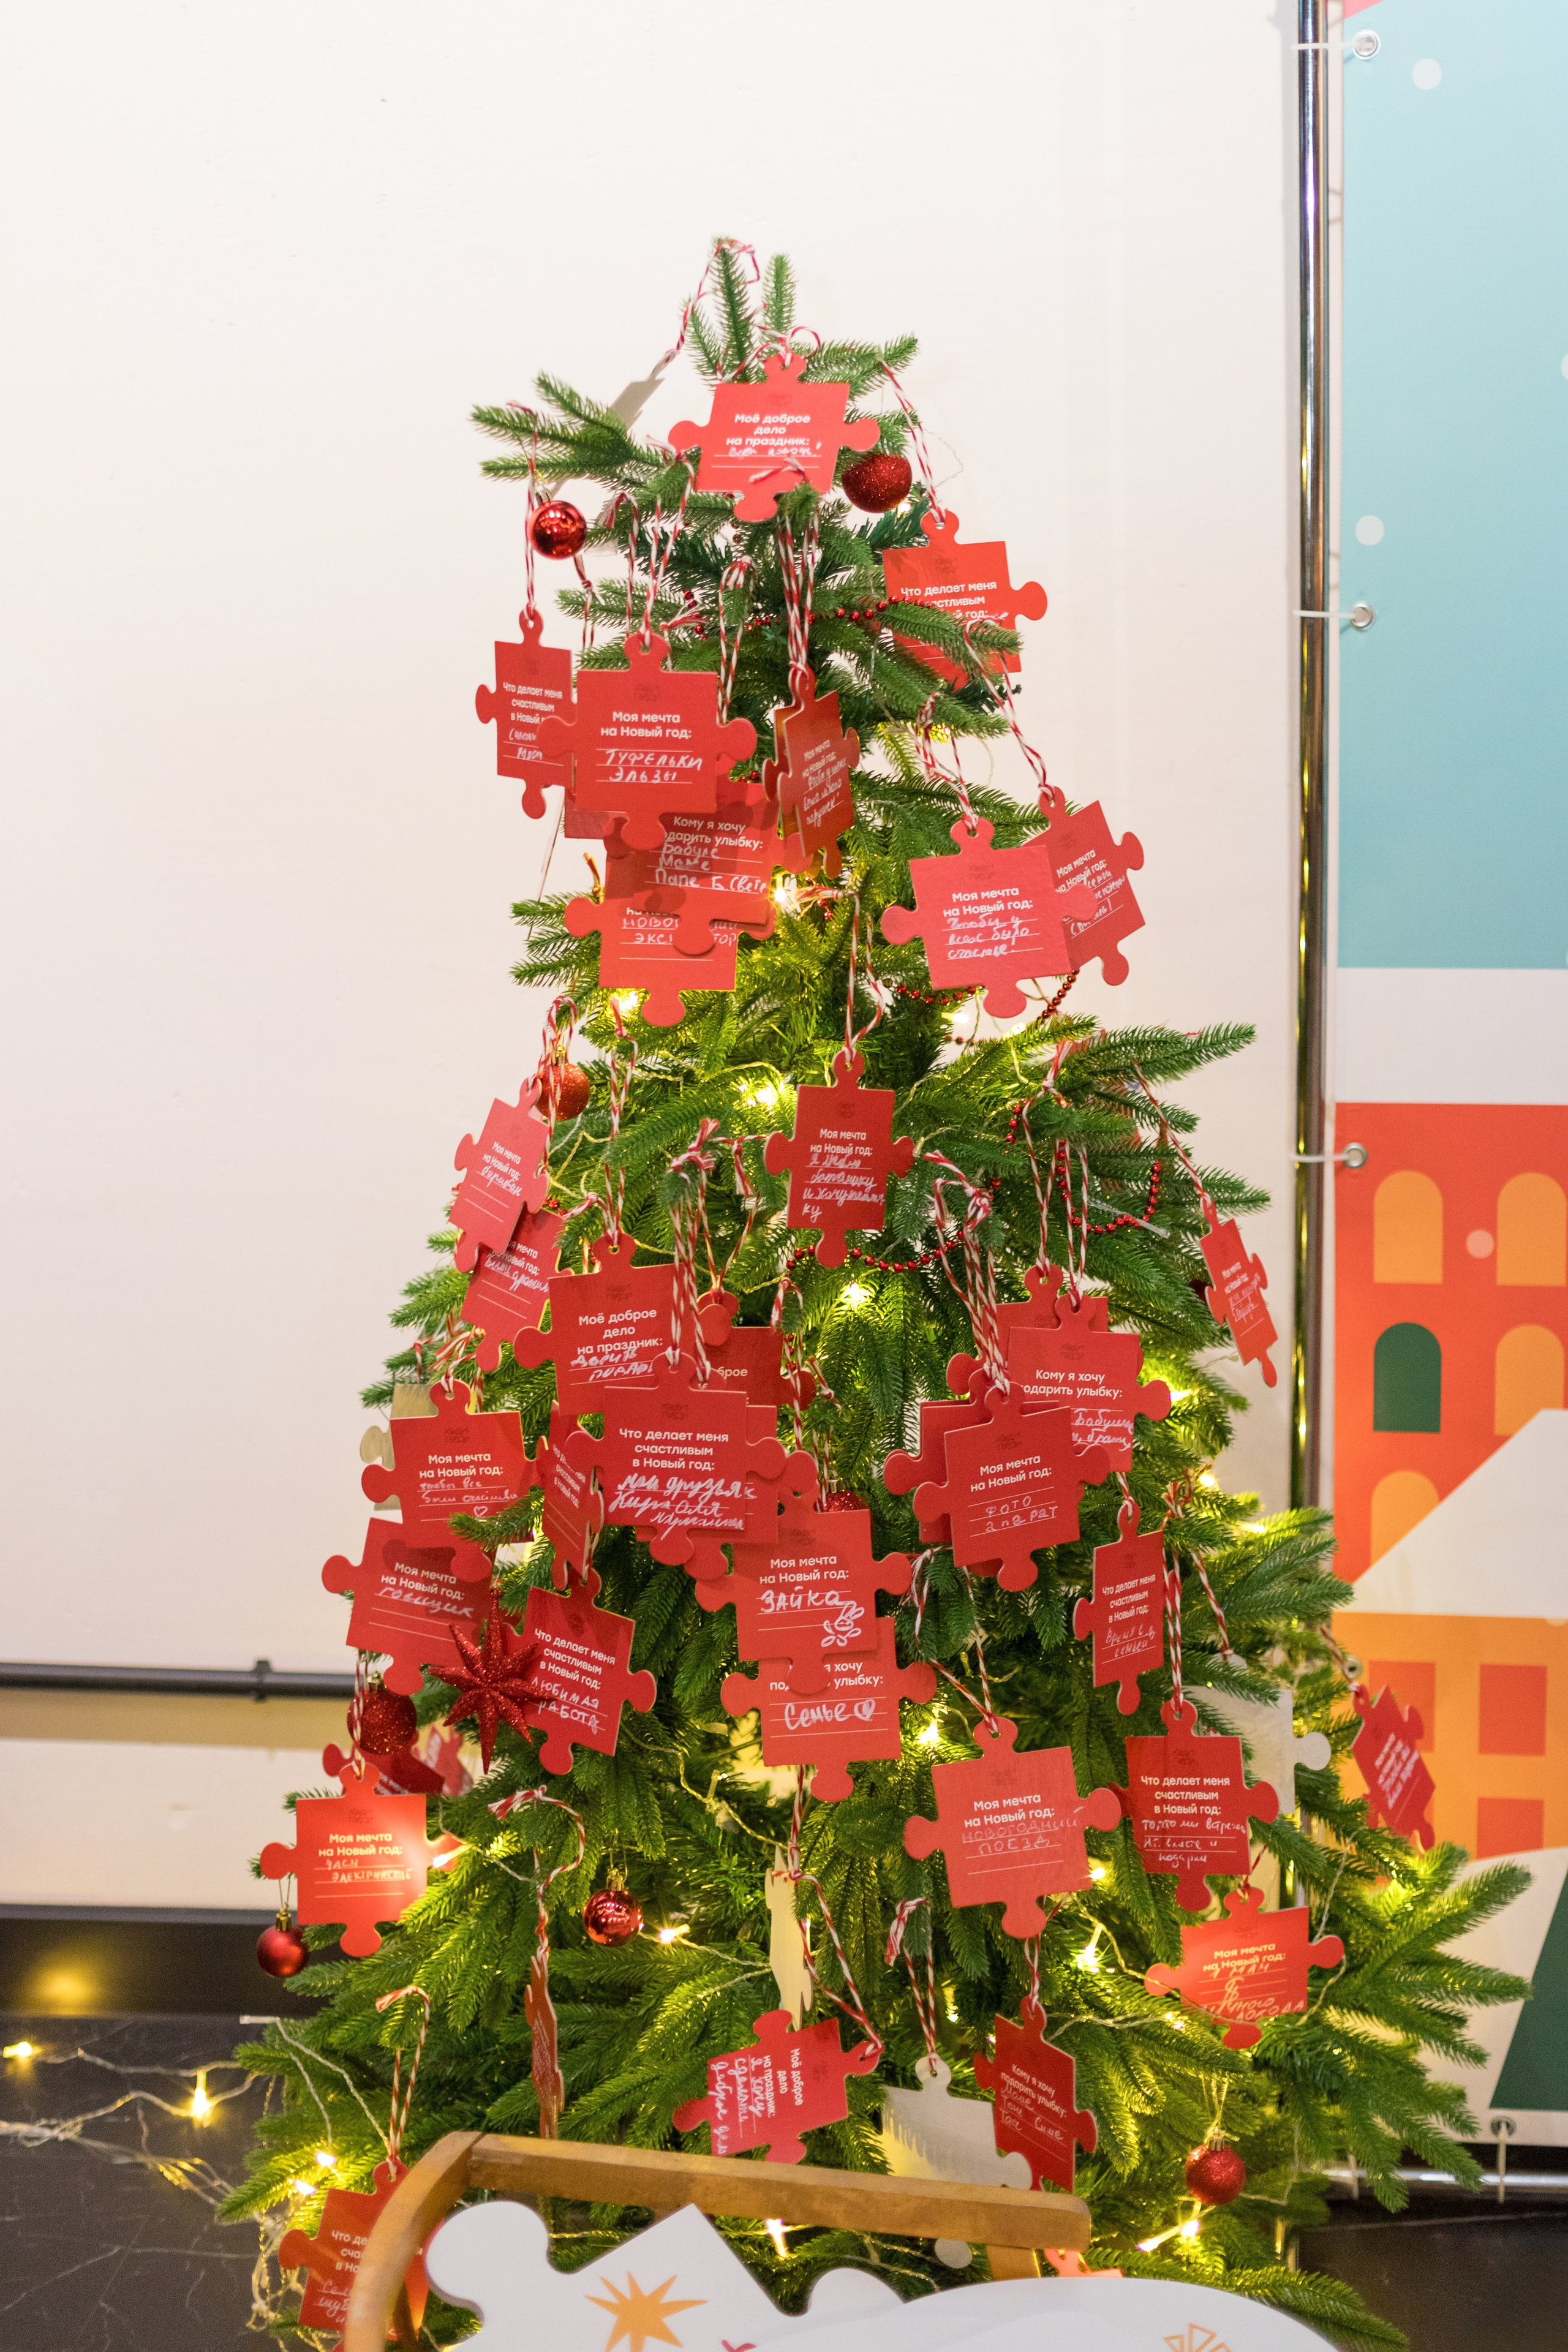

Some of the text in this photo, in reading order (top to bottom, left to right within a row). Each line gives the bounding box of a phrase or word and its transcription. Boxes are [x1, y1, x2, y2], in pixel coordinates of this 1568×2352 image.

[734, 414, 811, 425] Моё доброе
[745, 437, 810, 447] праздник:
[901, 582, 997, 597] Что делает меня
[612, 712, 680, 723] Моя мечта
[620, 726, 662, 737] Новый
[666, 729, 692, 739] год:
[674, 816, 746, 835] Кому я хочу
[715, 835, 763, 851] улыбку:
[1056, 849, 1096, 878] Моя мечта
[952, 888, 1019, 902] Моя мечта
[943, 900, 1033, 917] на Новый год:
[820, 1128, 837, 1139] Моя
[824, 1143, 853, 1155] Новый
[855, 1147, 873, 1156] год:
[516, 1243, 538, 1259] мечта
[525, 1264, 540, 1276] год:
[579, 1310, 657, 1326] Моё доброе
[603, 1326, 635, 1339] дело
[578, 1338, 663, 1355] на праздник:
[1036, 1370, 1065, 1382] Кому
[1078, 1373, 1105, 1385] хочу
[1022, 1385, 1123, 1400] одарить улыбку:
[619, 1428, 729, 1442] Что делает меня
[635, 1444, 713, 1456] счастливым
[428, 1453, 491, 1464] Моя мечта
[643, 1458, 685, 1469] Новый
[688, 1460, 715, 1471] год:
[980, 1455, 1041, 1476] Моя мечта
[438, 1466, 477, 1477] Новый
[480, 1466, 503, 1476] год:
[970, 1467, 1052, 1492] на Новый год:
[771, 1556, 837, 1569] Моя мечта
[394, 1562, 457, 1584] Моя мечта
[760, 1569, 849, 1585] на Новый год:
[381, 1575, 464, 1600] на Новый год:
[1102, 1574, 1156, 1596] Что делает меня
[1110, 1590, 1148, 1608] счастливым
[1114, 1606, 1135, 1621] Новый
[1136, 1605, 1149, 1615] год:
[535, 1629, 616, 1665] Что делает меня
[544, 1648, 602, 1675] счастливым
[834, 1662, 863, 1673] хочу
[540, 1661, 601, 1691] в Новый год:
[834, 1674, 883, 1689] улыбку:
[1141, 1776, 1159, 1785] Что
[1162, 1777, 1200, 1787] делает
[973, 1794, 1041, 1811] Моя мечта
[1155, 1791, 1219, 1800] счастливым
[1163, 1803, 1197, 1814] Новый
[1200, 1806, 1221, 1815] год:
[964, 1807, 1055, 1828] на Новый год:
[330, 1833, 393, 1844] Моя мечта
[318, 1845, 403, 1856] на Новый год:
[1214, 1943, 1276, 1959] Моя мечта
[1203, 1963, 1219, 1972] на
[1221, 1955, 1259, 1969] Новый
[1262, 1953, 1286, 1962] год:
[777, 2070, 788, 2094] дело
[791, 2048, 804, 2106] Моё доброе
[1012, 2064, 1031, 2083] Кому
[1038, 2081, 1055, 2098] хочу
[763, 2055, 775, 2118] на праздник:
[1001, 2072, 1066, 2118] подарить улыбку:
[331, 2230, 351, 2242] Что
